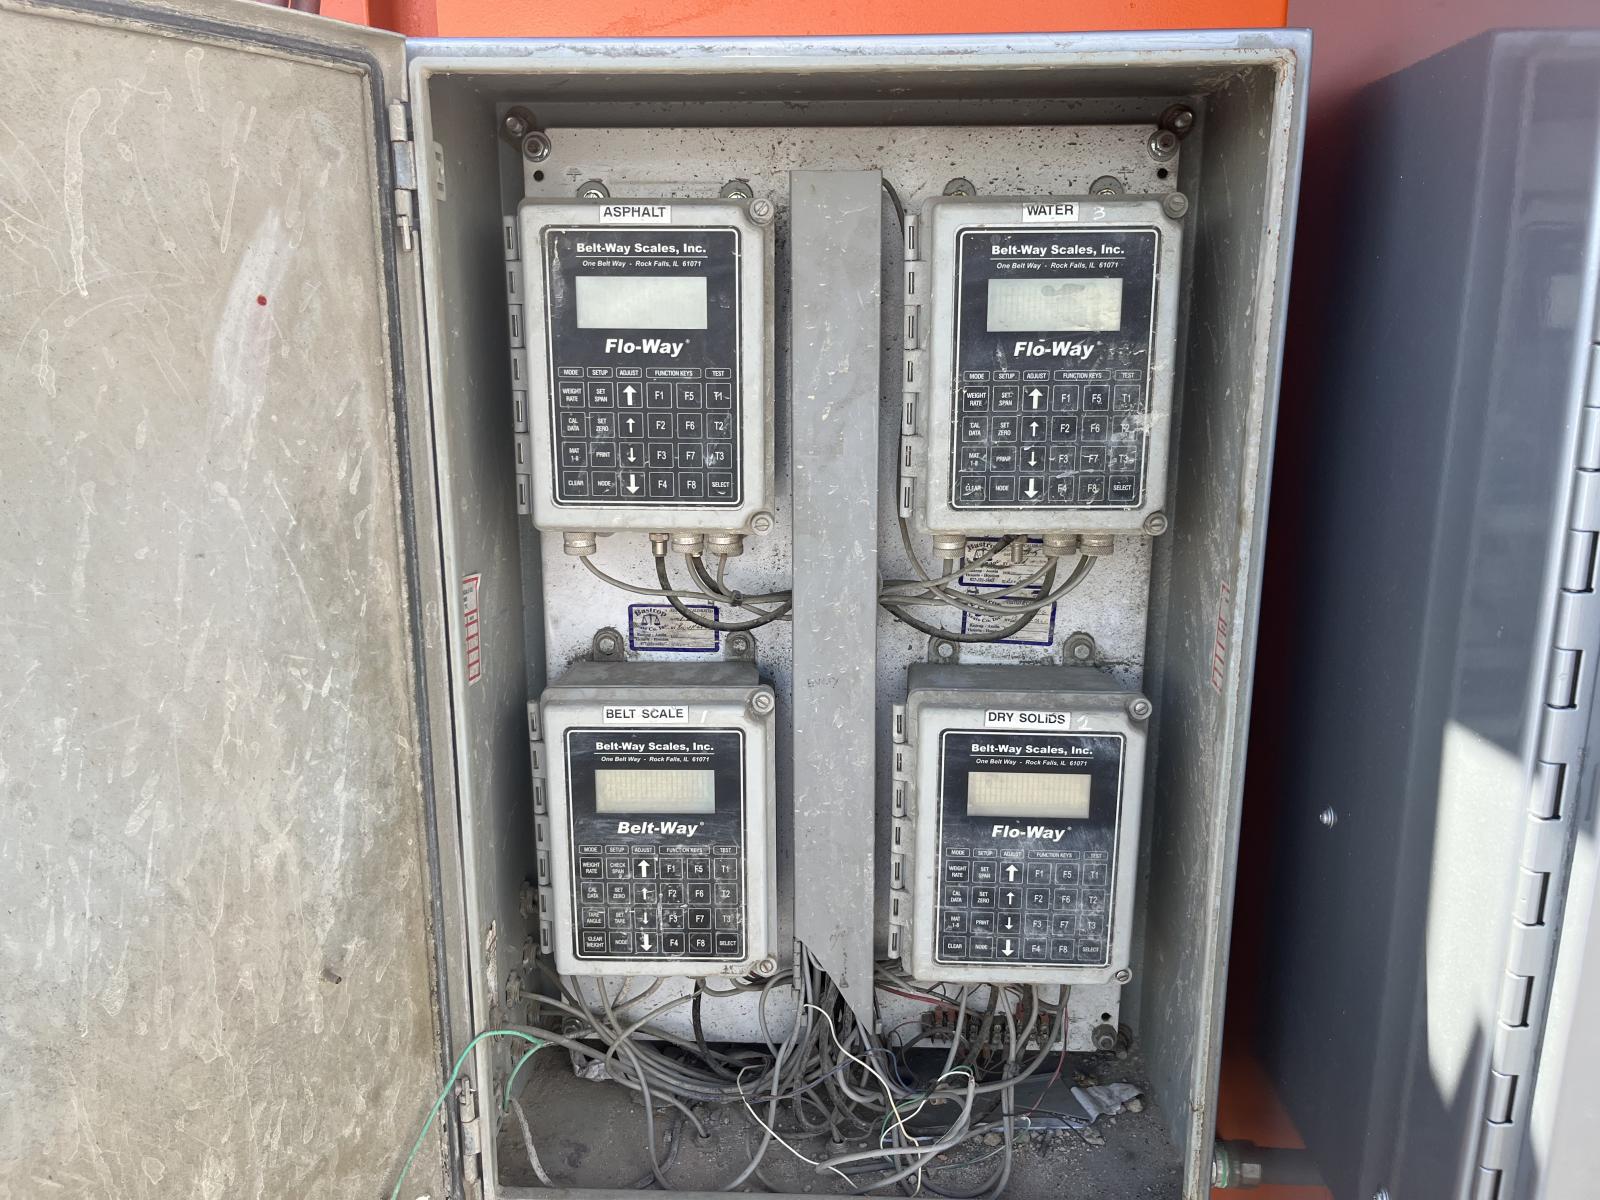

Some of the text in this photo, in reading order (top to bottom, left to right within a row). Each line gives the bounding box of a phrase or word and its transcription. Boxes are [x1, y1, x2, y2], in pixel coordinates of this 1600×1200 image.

[604, 207, 666, 217] ASPHALT
[1027, 205, 1074, 215] WATER
[577, 243, 706, 254] Belt-Way Scales, Inc.
[992, 245, 1124, 256] Belt-Way Scales, Inc.
[1027, 262, 1041, 270] Way
[605, 339, 683, 357] Flo-Way
[1014, 341, 1094, 359] Flo-Way
[655, 391, 664, 400] F1
[685, 392, 694, 400] F5
[714, 392, 723, 400] T1
[1062, 394, 1070, 403] F1
[1092, 394, 1101, 403] F5
[1122, 394, 1131, 402] T1
[656, 421, 666, 429] F2
[686, 421, 695, 430] F6
[714, 422, 723, 430] T2
[1060, 424, 1069, 432] F2
[1091, 424, 1100, 432] F6
[657, 451, 666, 460] F3
[686, 451, 695, 460] F7
[715, 452, 724, 460] T3
[1059, 455, 1068, 463] F3
[1089, 455, 1098, 463] F7
[1119, 455, 1128, 463] T3
[687, 481, 696, 489] F8
[1058, 484, 1067, 492] F4
[1088, 484, 1097, 492] F8
[634, 608, 667, 617] Bastrop
[606, 708, 683, 718] BELT SCALE
[988, 712, 1014, 722] DRY
[596, 743, 645, 752] Belt-Way
[649, 743, 690, 752] Scales,
[972, 744, 1092, 755] Belt-Way Scales, Inc.
[618, 822, 698, 837] Belt-Way
[992, 825, 1065, 842] Flo-Way
[1089, 896, 1097, 904] T2
[722, 915, 731, 923] T3
[1088, 921, 1095, 929] T3
[697, 939, 705, 947] F8
